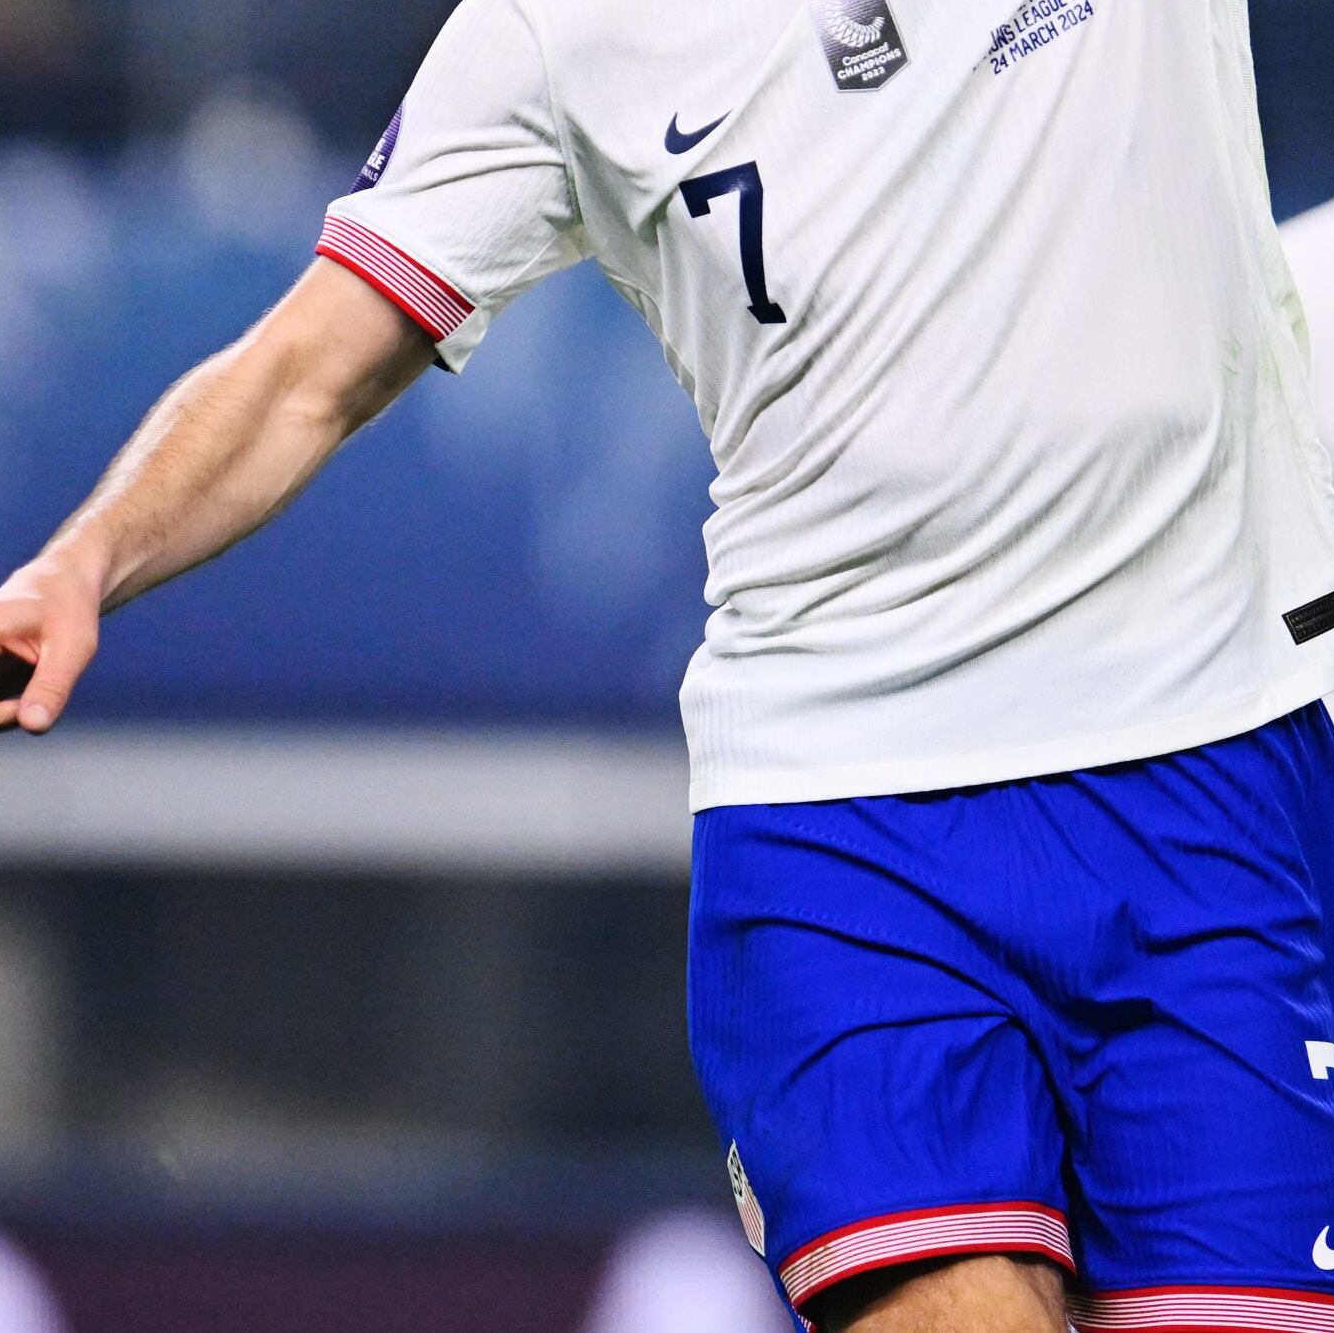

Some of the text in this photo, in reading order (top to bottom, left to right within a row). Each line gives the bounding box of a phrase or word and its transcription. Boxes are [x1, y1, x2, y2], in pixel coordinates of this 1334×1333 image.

[842, 41, 890, 67] Concacaf
[990, 53, 1009, 75] 24
[1009, 21, 1060, 63] MARCH
[1057, 0, 1094, 32] 2024
[836, 47, 903, 81] CHAMPIONS
[861, 66, 886, 82] 2023
[677, 159, 787, 325] 7
